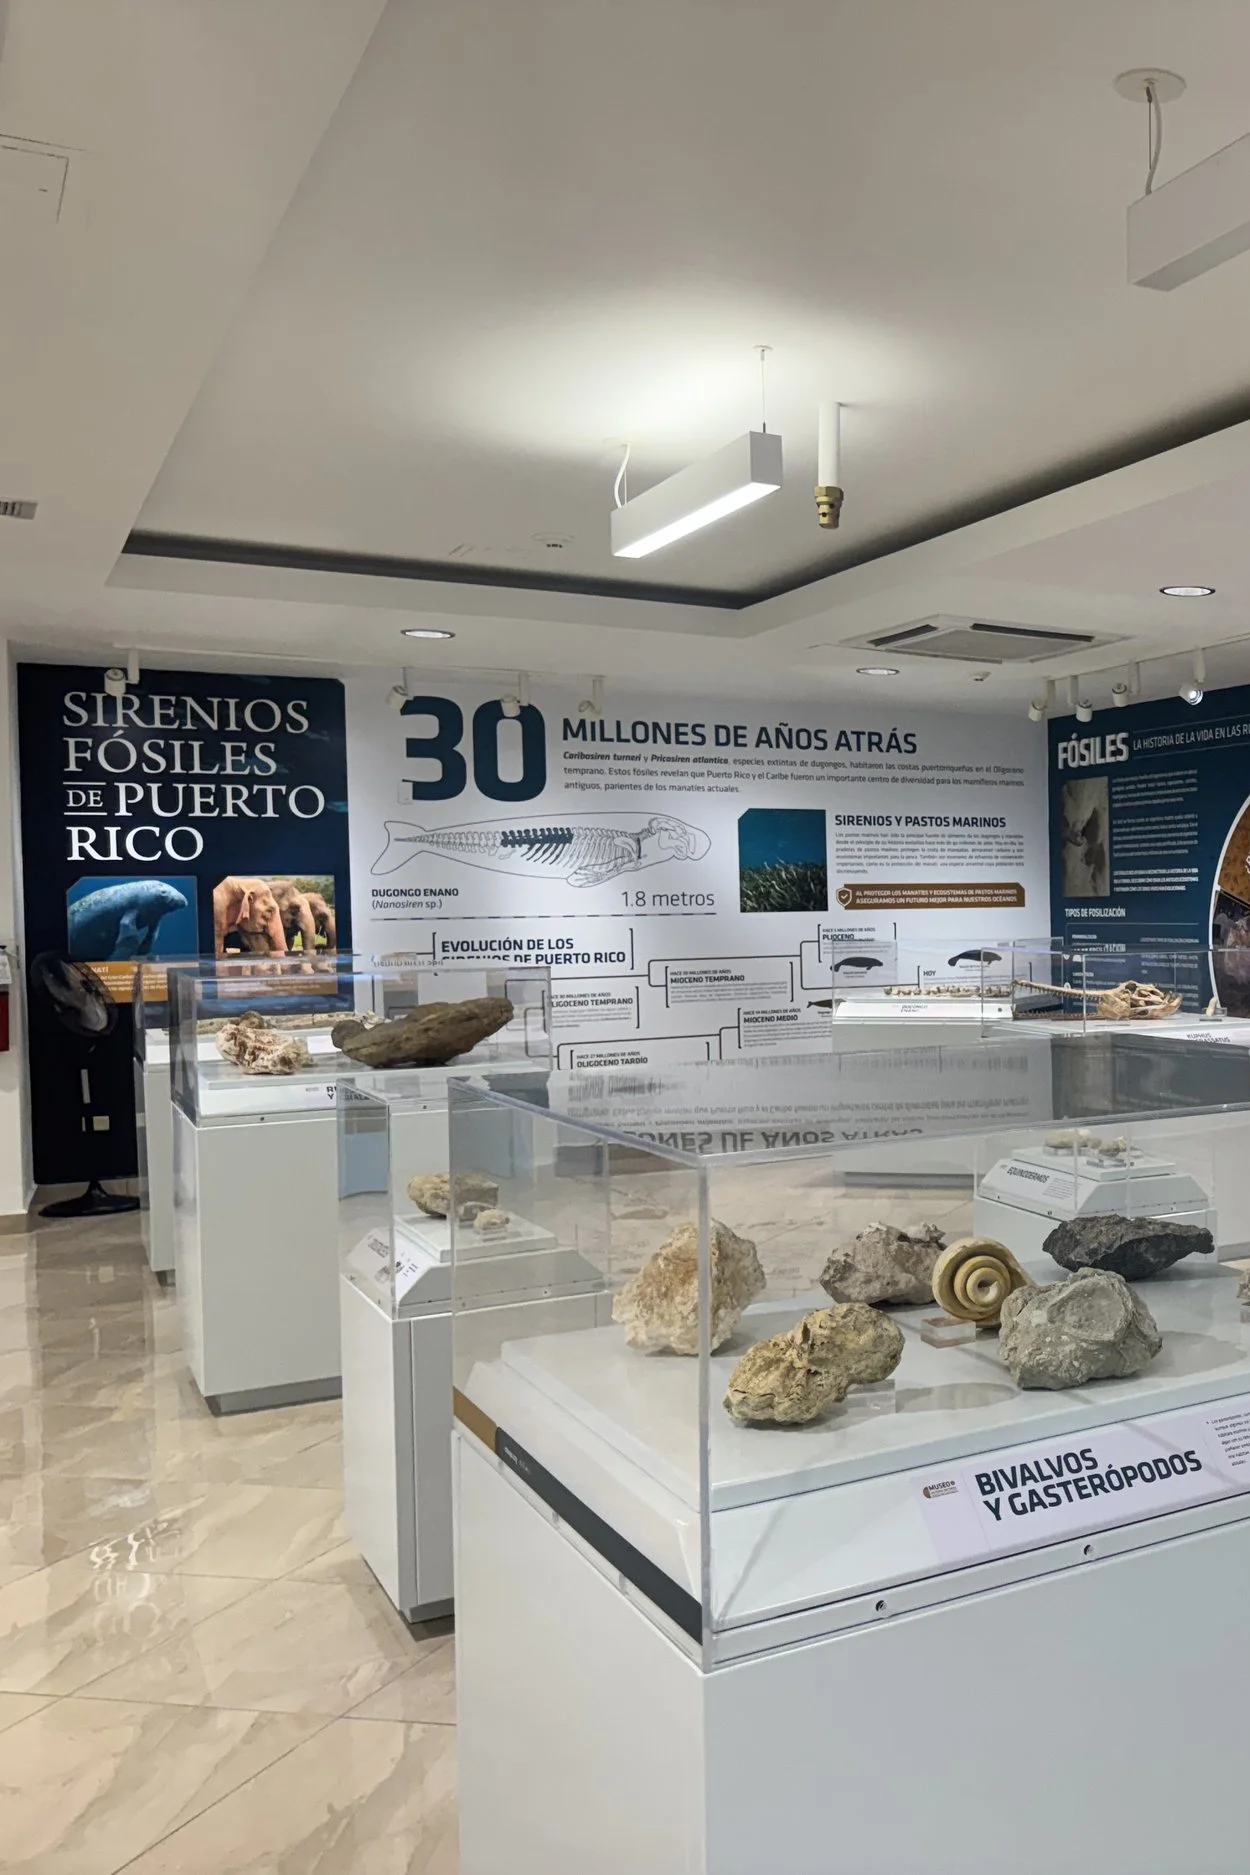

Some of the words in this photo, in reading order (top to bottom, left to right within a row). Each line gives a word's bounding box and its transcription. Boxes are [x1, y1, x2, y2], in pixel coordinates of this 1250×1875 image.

[63, 692, 309, 734] SIRENIOS
[562, 718, 706, 746] MILLONES
[714, 724, 748, 748] DE
[755, 722, 828, 751] AÑOS
[835, 726, 917, 754] ATRÁS
[63, 730, 276, 776] FÓSILES
[400, 696, 547, 802] 30
[1058, 732, 1129, 770] FÓSILES
[1133, 740, 1142, 751] LA
[1143, 735, 1174, 750] HISTORIA
[1175, 734, 1185, 745] DE
[1187, 733, 1195, 743] LA
[1197, 731, 1213, 742] VIDA
[1215, 729, 1225, 739] EN
[1226, 725, 1241, 738] LAS
[613, 753, 641, 762] turneri
[644, 756, 648, 765] y
[733, 758, 764, 768] especies
[800, 759, 808, 767] de
[886, 762, 895, 770] las
[898, 762, 919, 771] costas
[609, 767, 630, 776] Estos
[633, 768, 658, 777] fósiles
[661, 769, 688, 778] revelan
[691, 771, 704, 780] que
[707, 770, 732, 779] Puerto
[734, 770, 750, 779] Rico
[752, 773, 756, 782] y
[758, 771, 764, 780] el
[766, 771, 788, 780] Caribe
[791, 772, 814, 781] fueron
[827, 773, 866, 784] importante
[868, 774, 889, 783] centro
[891, 775, 899, 783] de
[901, 775, 934, 784] diversidad
[936, 778, 950, 786] para
[952, 776, 962, 785] los
[605, 782, 642, 792] parientes
[644, 782, 654, 791] de
[656, 783, 667, 791] los
[66, 789, 103, 807] DE
[114, 782, 325, 819] PUERTO
[835, 815, 893, 826] SIRENIOS
[895, 816, 902, 826] Y
[905, 816, 950, 827] PASTOS
[952, 817, 1006, 828] MARINOS
[66, 826, 204, 862] RICO
[372, 889, 421, 897] DUGONGO
[423, 888, 459, 896] ENANO
[622, 891, 646, 907] 1.8
[652, 893, 715, 906] metros
[372, 899, 423, 909] (Nanosiren
[425, 899, 442, 910] sp.)
[1065, 908, 1080, 917] TIPOS
[1081, 908, 1088, 917] DE
[1088, 906, 1126, 917] FOSILIZACIÓN
[442, 937, 522, 952] EVOLUCIÓN
[527, 939, 543, 950] DE
[548, 938, 574, 950] LOS
[535, 952, 593, 964] PUERTO
[594, 951, 626, 963] RICO
[577, 1059, 618, 1068] OLIGOCENO
[621, 1057, 648, 1065] TARDÍO
[975, 1448, 1098, 1497] BIVALVOS
[929, 1481, 950, 1490] MUSEO
[982, 1499, 1003, 1521] Y
[1009, 1450, 1202, 1517] GASTERÓPODOS
